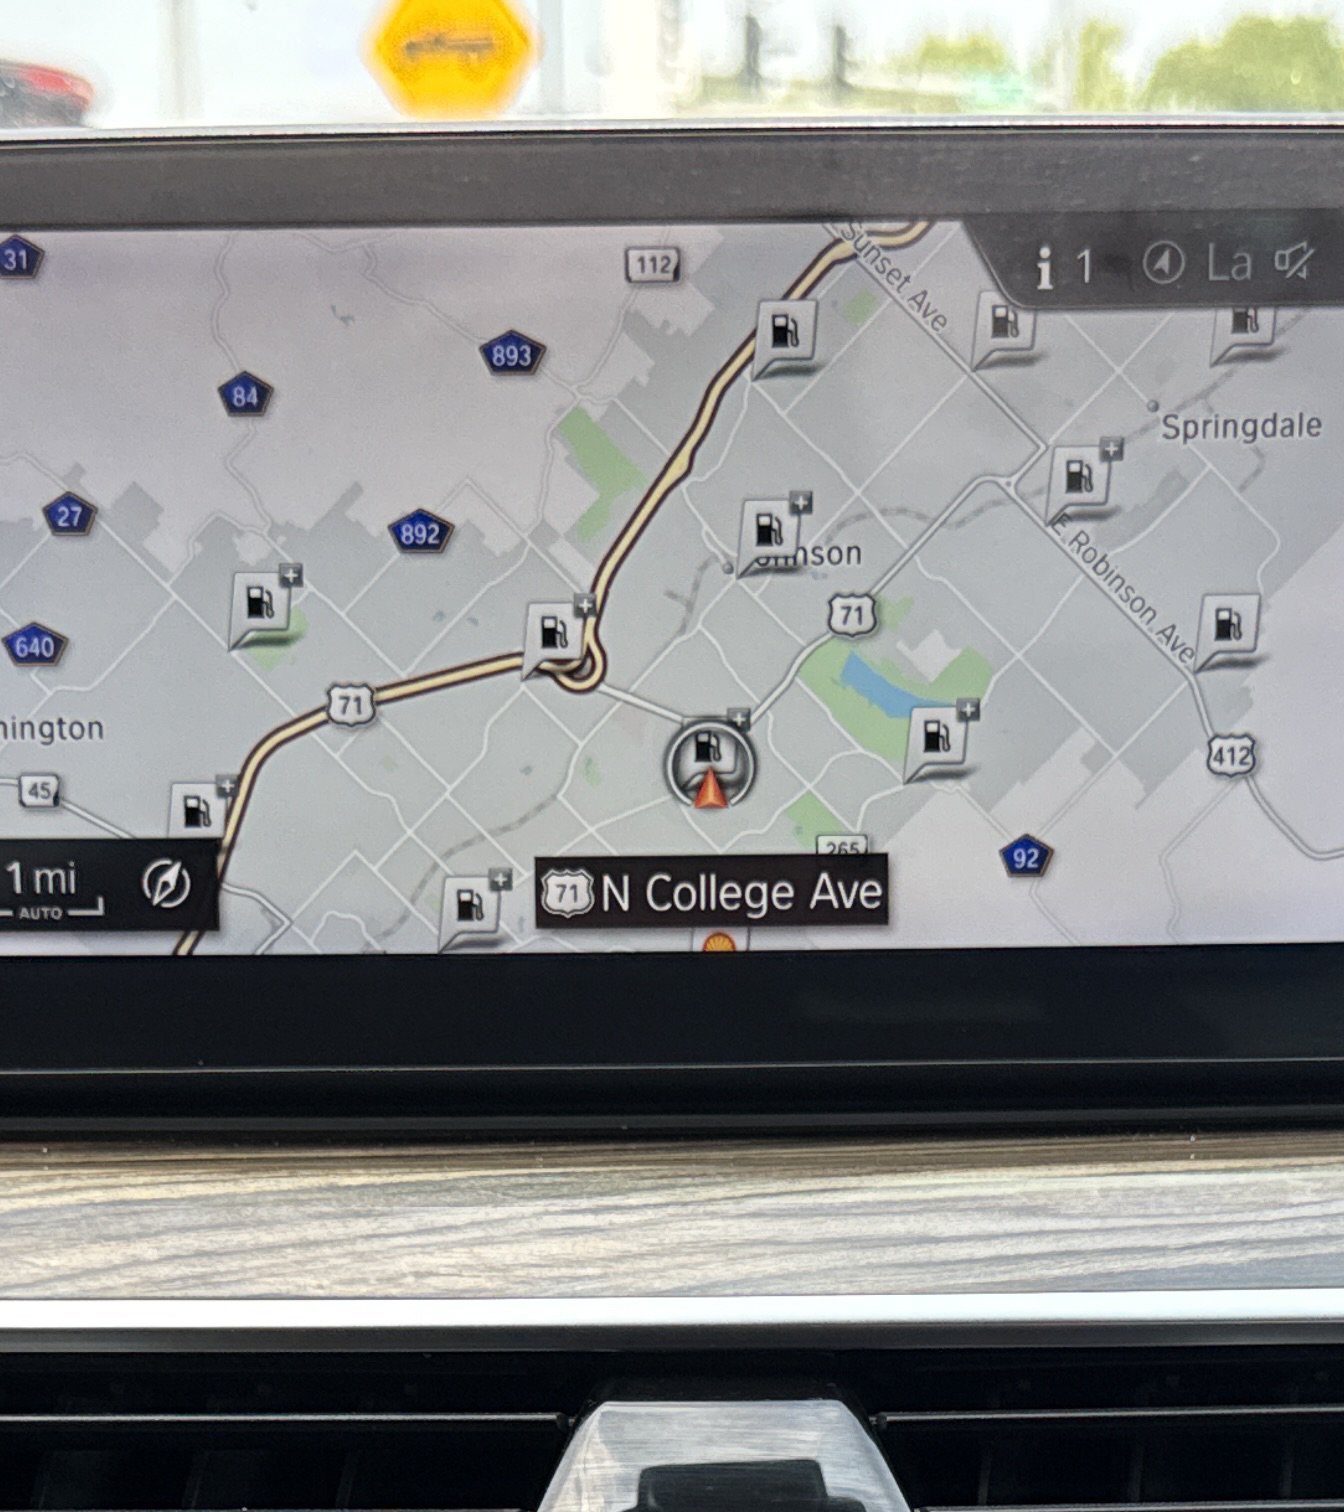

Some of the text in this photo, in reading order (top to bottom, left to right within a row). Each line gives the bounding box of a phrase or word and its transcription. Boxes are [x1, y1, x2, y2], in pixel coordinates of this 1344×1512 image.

[3, 248, 29, 272] 31
[636, 255, 672, 275] 112
[1076, 248, 1092, 284] 1
[1207, 242, 1253, 281] La
[840, 221, 948, 332] Sunset Ave
[491, 345, 532, 368] 893
[232, 386, 259, 407] 84
[1161, 412, 1323, 444] Springdale
[56, 506, 82, 527] 27
[400, 524, 440, 546] 892
[1067, 529, 1157, 626] Robinson
[1154, 623, 1196, 664] Ave
[839, 605, 864, 625] 71
[14, 636, 55, 658] 640
[337, 695, 365, 717] 71
[1212, 746, 1252, 768] 412
[27, 780, 53, 801] 45
[1011, 847, 1040, 870] 92
[5, 860, 77, 895] 1 mi
[554, 871, 884, 920] 71 N College Ave
[18, 907, 63, 921] AUTO
